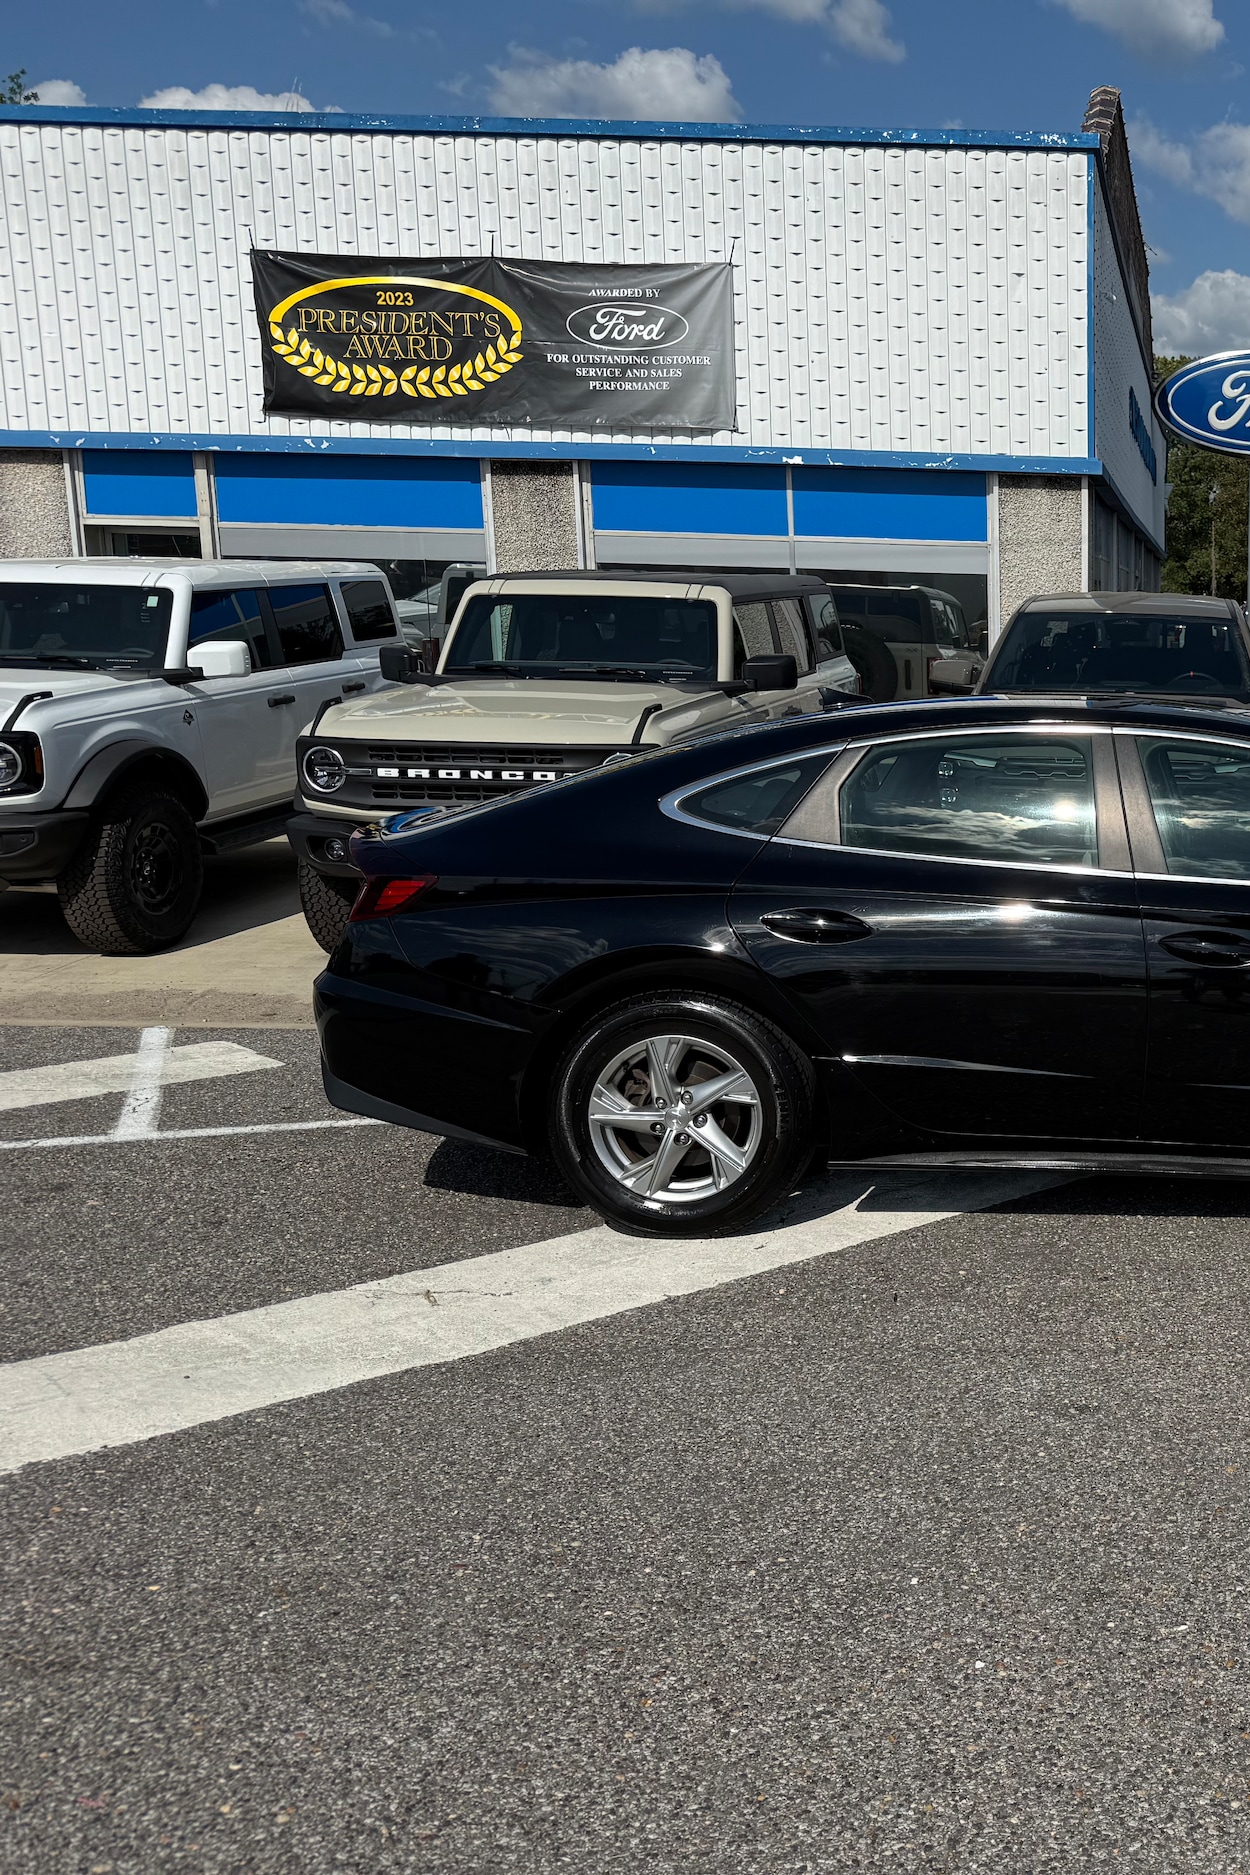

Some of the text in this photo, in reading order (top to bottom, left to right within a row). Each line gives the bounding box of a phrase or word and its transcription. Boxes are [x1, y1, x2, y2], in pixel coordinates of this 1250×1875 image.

[376, 291, 414, 306] 2023
[588, 288, 660, 298] AWARDED BY
[297, 308, 501, 338] PRESIDENT'S
[589, 308, 665, 341] Ford
[343, 335, 453, 361] AWARD
[547, 353, 711, 365] FOR OUTSTANDING CUSTOMER
[576, 367, 682, 377] SERVICE AND SALES
[589, 381, 670, 391] PERFORMANCE
[377, 767, 556, 781] BRONCO
